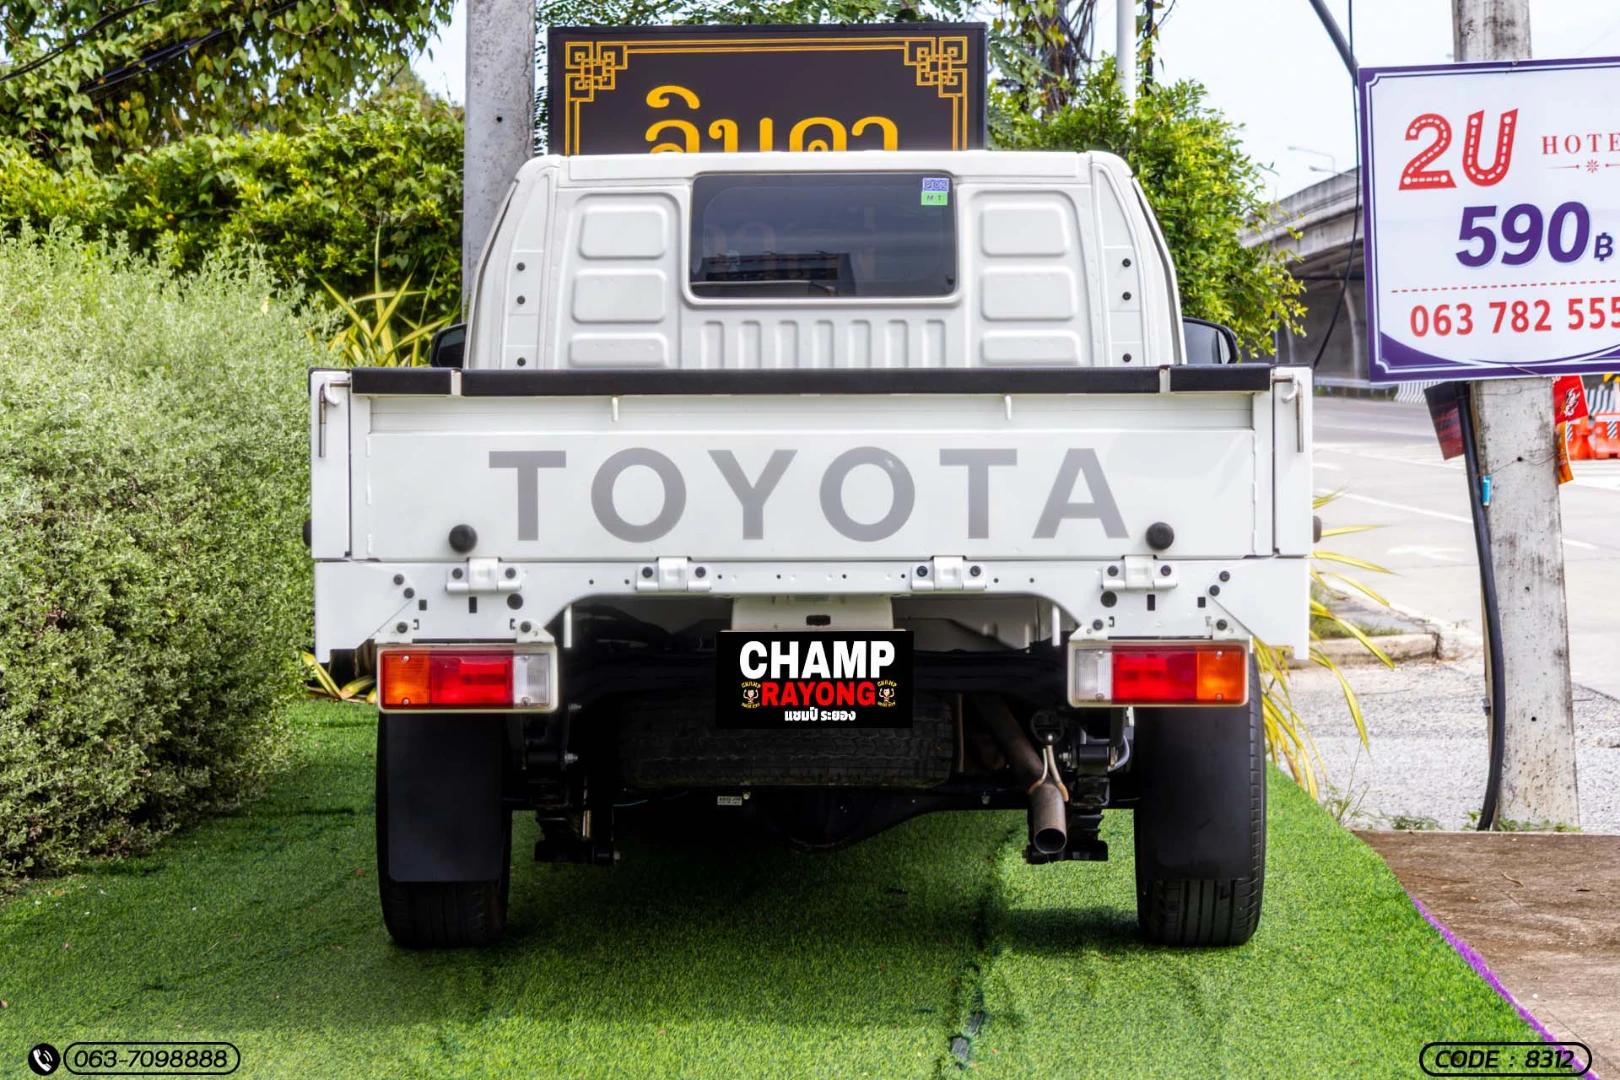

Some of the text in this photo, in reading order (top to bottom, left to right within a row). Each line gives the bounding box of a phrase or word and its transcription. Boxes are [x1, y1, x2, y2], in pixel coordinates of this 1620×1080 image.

[1398, 108, 1519, 190] 2U
[1410, 303, 1474, 337] 063
[1489, 299, 1552, 334] 782
[489, 446, 1130, 542] TOYOTA
